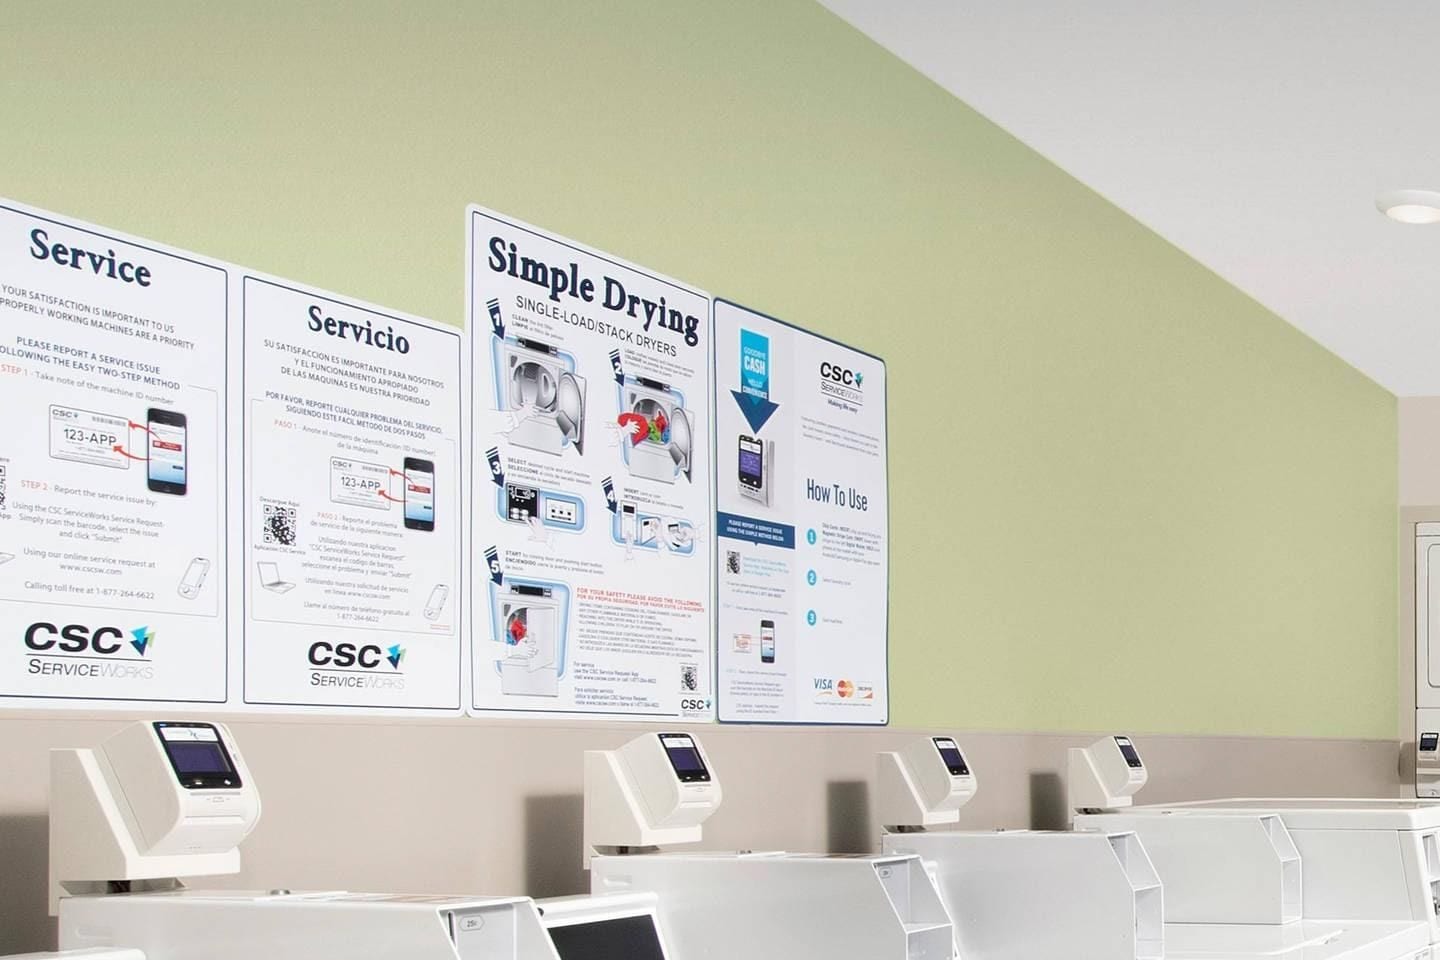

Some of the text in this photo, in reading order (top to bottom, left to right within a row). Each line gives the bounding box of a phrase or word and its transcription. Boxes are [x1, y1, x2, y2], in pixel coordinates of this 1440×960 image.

[30, 228, 151, 287] Service
[488, 236, 700, 347] Simple Drying
[1, 284, 175, 334] YOUR SATISFACTION IS IMPORTANT TO US
[493, 313, 501, 326] 1
[0, 298, 195, 351] PROPERLY WORKING MACHINES ARE A PRIORITY
[308, 305, 410, 354] Servicio
[515, 295, 633, 343] SINGLE-LOAD/STACK
[636, 334, 677, 357] DRYERS
[17, 336, 161, 375] PLEASE REPORT A SERVICE ISSUE
[264, 339, 274, 348] SU
[331, 354, 340, 364] ES
[341, 358, 387, 375] IMPORTANTE
[388, 369, 406, 380] PARA
[408, 373, 445, 389] NOSOTROS
[744, 355, 765, 376] CASH
[1, 363, 22, 375] STEP
[35, 371, 54, 382] Take
[56, 377, 75, 387] note
[77, 380, 85, 388] of
[86, 381, 99, 390] the
[101, 385, 134, 398] machine
[53, 356, 70, 368] THE
[72, 360, 95, 373] EASY
[98, 366, 142, 381] TWO-STEP
[143, 375, 181, 391] METHOD
[294, 358, 419, 393] Y EL FUNCIONAMIENTO APROPIADO
[615, 361, 623, 376] 2
[820, 362, 853, 385] CSC
[281, 367, 430, 406] DE LAS MAQUINAS ES NUESTRA PRIORIDAD
[265, 391, 414, 429] POR FAVOR, REPORTE CUALQUIER PROBLEMA DEL
[286, 405, 425, 440] SIGUIENDO ESTE FACIL METODO DE DOS PASOS
[63, 428, 117, 446] 123-APP
[491, 460, 501, 475] 3
[21, 480, 41, 489] STEP
[54, 485, 80, 497] Report
[341, 476, 381, 490] 123-APP
[807, 478, 868, 512] How To Use
[12, 501, 34, 513] Using
[35, 504, 47, 512] the
[48, 505, 62, 515] CSC
[23, 548, 46, 558] Using
[491, 560, 500, 573] 5
[809, 572, 815, 583] 2
[24, 581, 52, 592] Calling
[54, 582, 68, 591] toll
[69, 584, 86, 593] free
[590, 588, 604, 596] YOUR
[606, 590, 626, 599] SAFETY
[809, 612, 815, 623] 3
[24, 622, 123, 654] CSC
[308, 641, 381, 669] CSC
[814, 678, 833, 690] VISA
[681, 699, 704, 710] CSC
